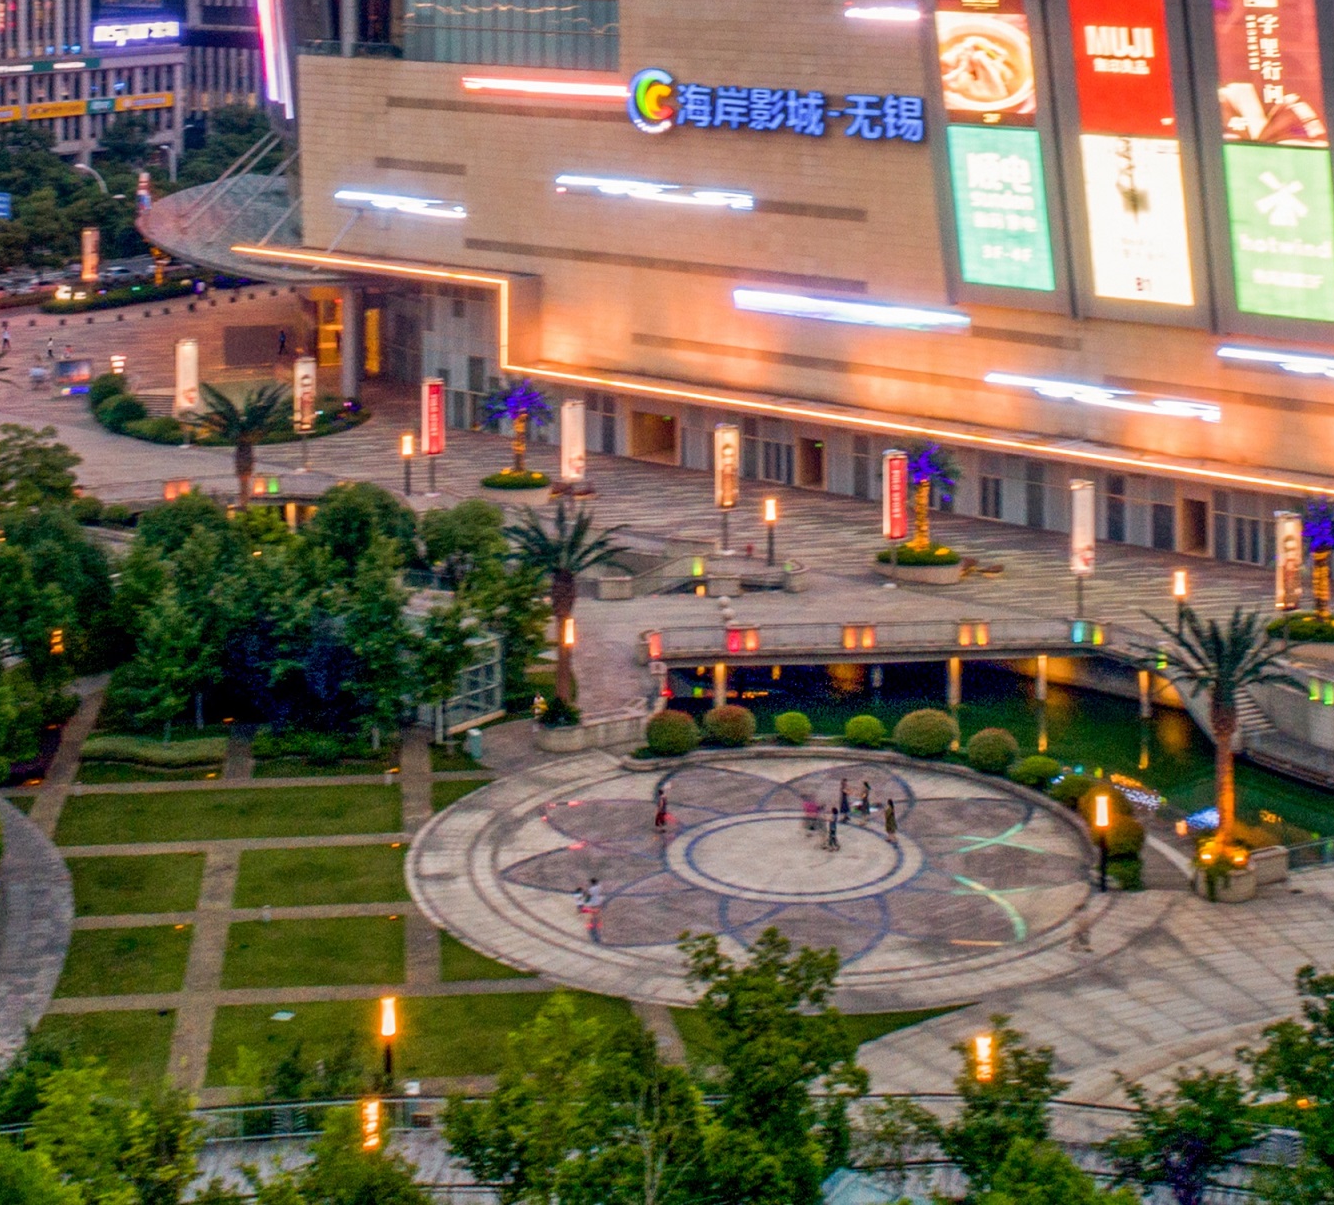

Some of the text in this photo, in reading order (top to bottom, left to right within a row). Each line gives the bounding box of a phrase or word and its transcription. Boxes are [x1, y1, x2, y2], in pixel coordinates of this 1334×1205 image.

[1084, 25, 1155, 58] MUJI
[1257, 13, 1283, 105] 字里行间
[966, 152, 1033, 193] 顺电
